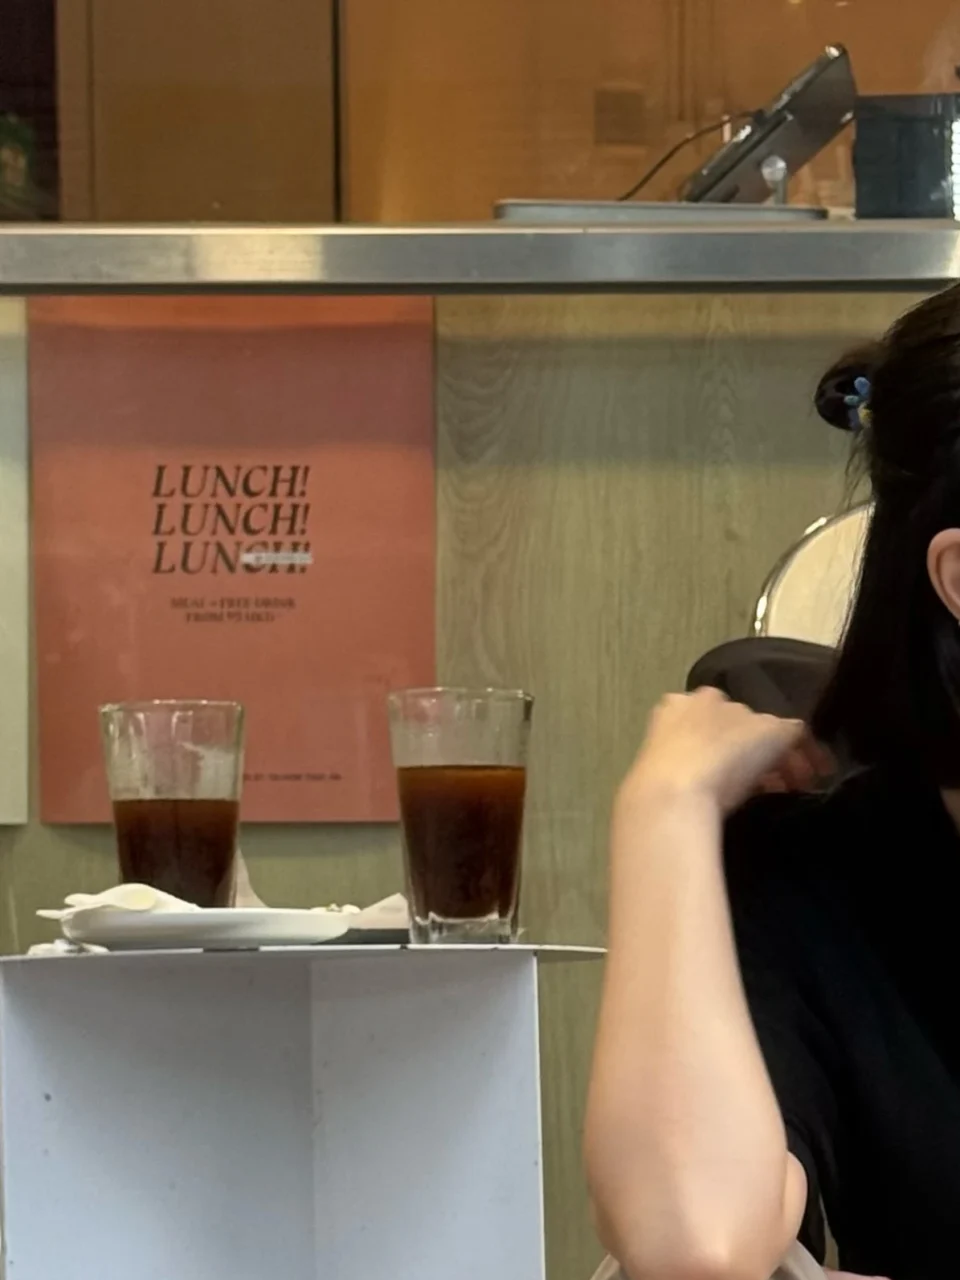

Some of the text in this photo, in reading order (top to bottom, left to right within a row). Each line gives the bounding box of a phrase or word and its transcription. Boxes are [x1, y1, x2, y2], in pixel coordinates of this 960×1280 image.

[151, 464, 311, 498] LUNCH!
[151, 502, 311, 536] LUNCH!
[151, 540, 311, 575] LUNCH!
